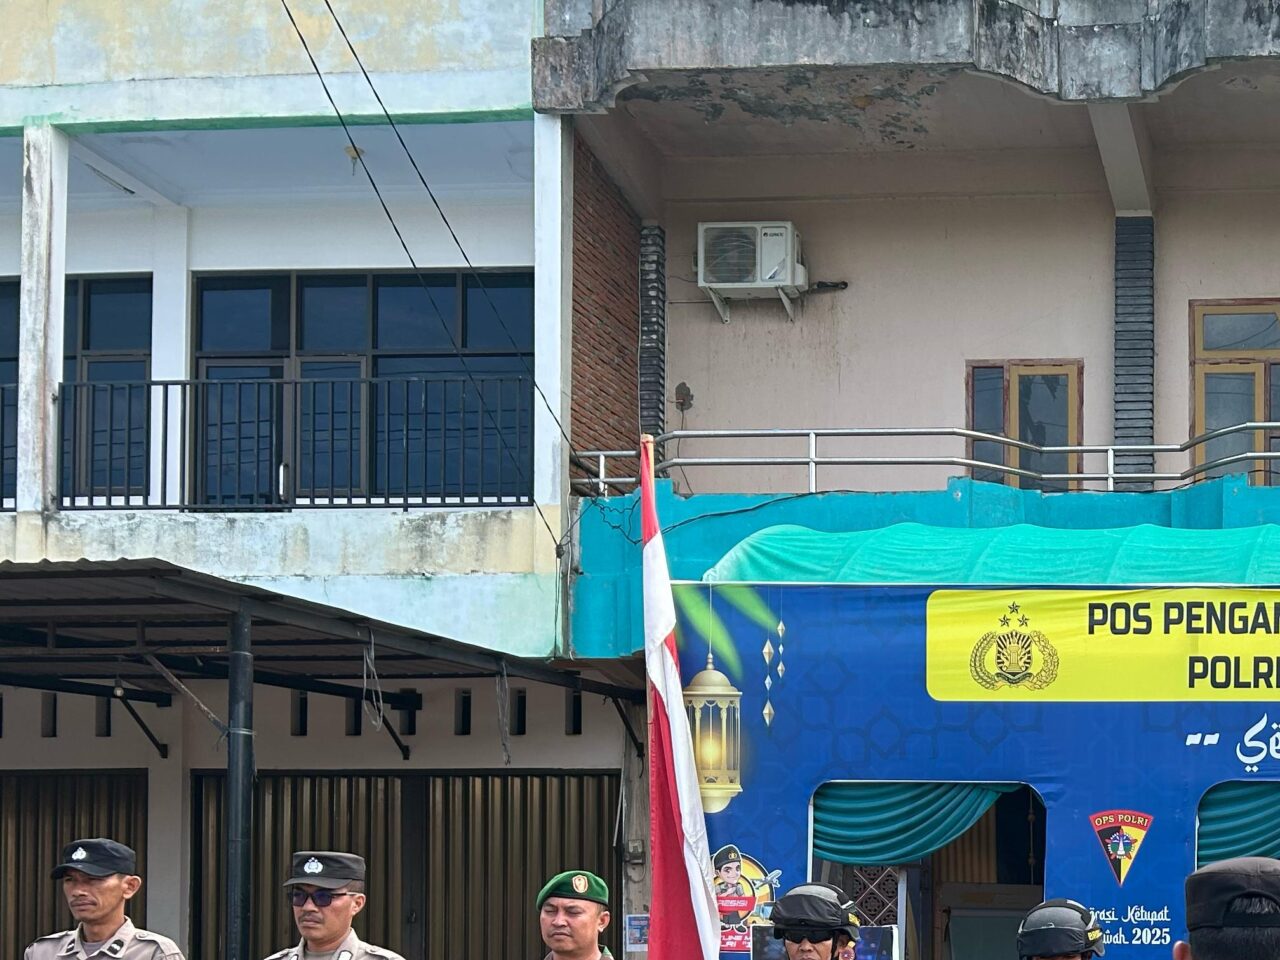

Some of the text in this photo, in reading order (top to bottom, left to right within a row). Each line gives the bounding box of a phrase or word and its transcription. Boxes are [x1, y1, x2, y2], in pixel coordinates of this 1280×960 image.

[1088, 602, 1152, 635] POS
[1095, 814, 1149, 827] OPS POLRI
[1132, 927, 1171, 945] 2025
